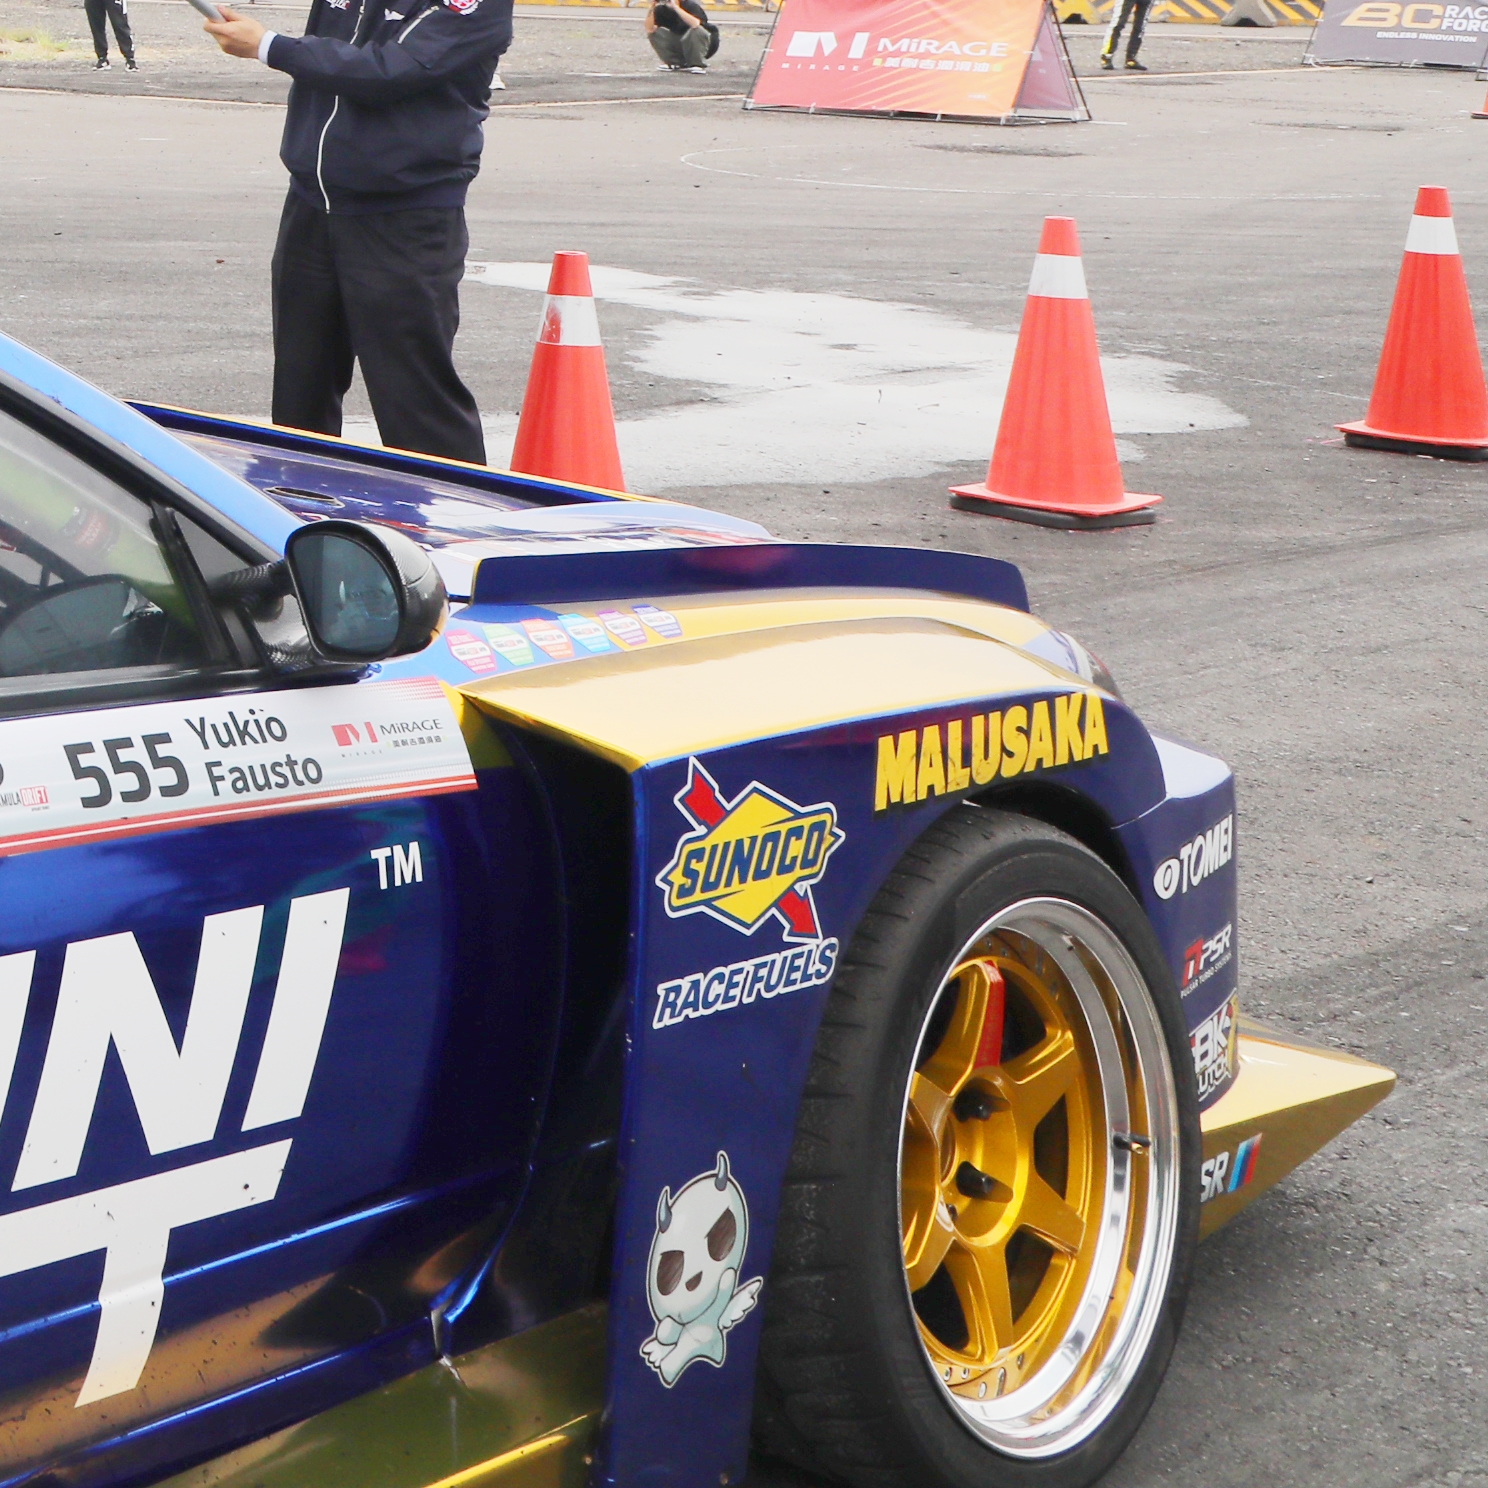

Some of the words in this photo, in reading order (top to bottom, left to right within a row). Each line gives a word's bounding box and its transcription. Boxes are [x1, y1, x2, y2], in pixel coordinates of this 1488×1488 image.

[1376, 31, 1418, 40] ENDLESS
[1418, 32, 1478, 43] INNOVATION
[62, 731, 191, 810] 555
[185, 708, 288, 751] Yukio
[205, 752, 323, 798] Fausto
[874, 689, 1109, 813] MALUSAKA
[20, 786, 49, 807] DRIFT
[675, 820, 829, 894] SUNOCO
[1179, 814, 1233, 893] TOMEI
[653, 964, 744, 1029] RACE
[742, 937, 839, 1002] FUELS
